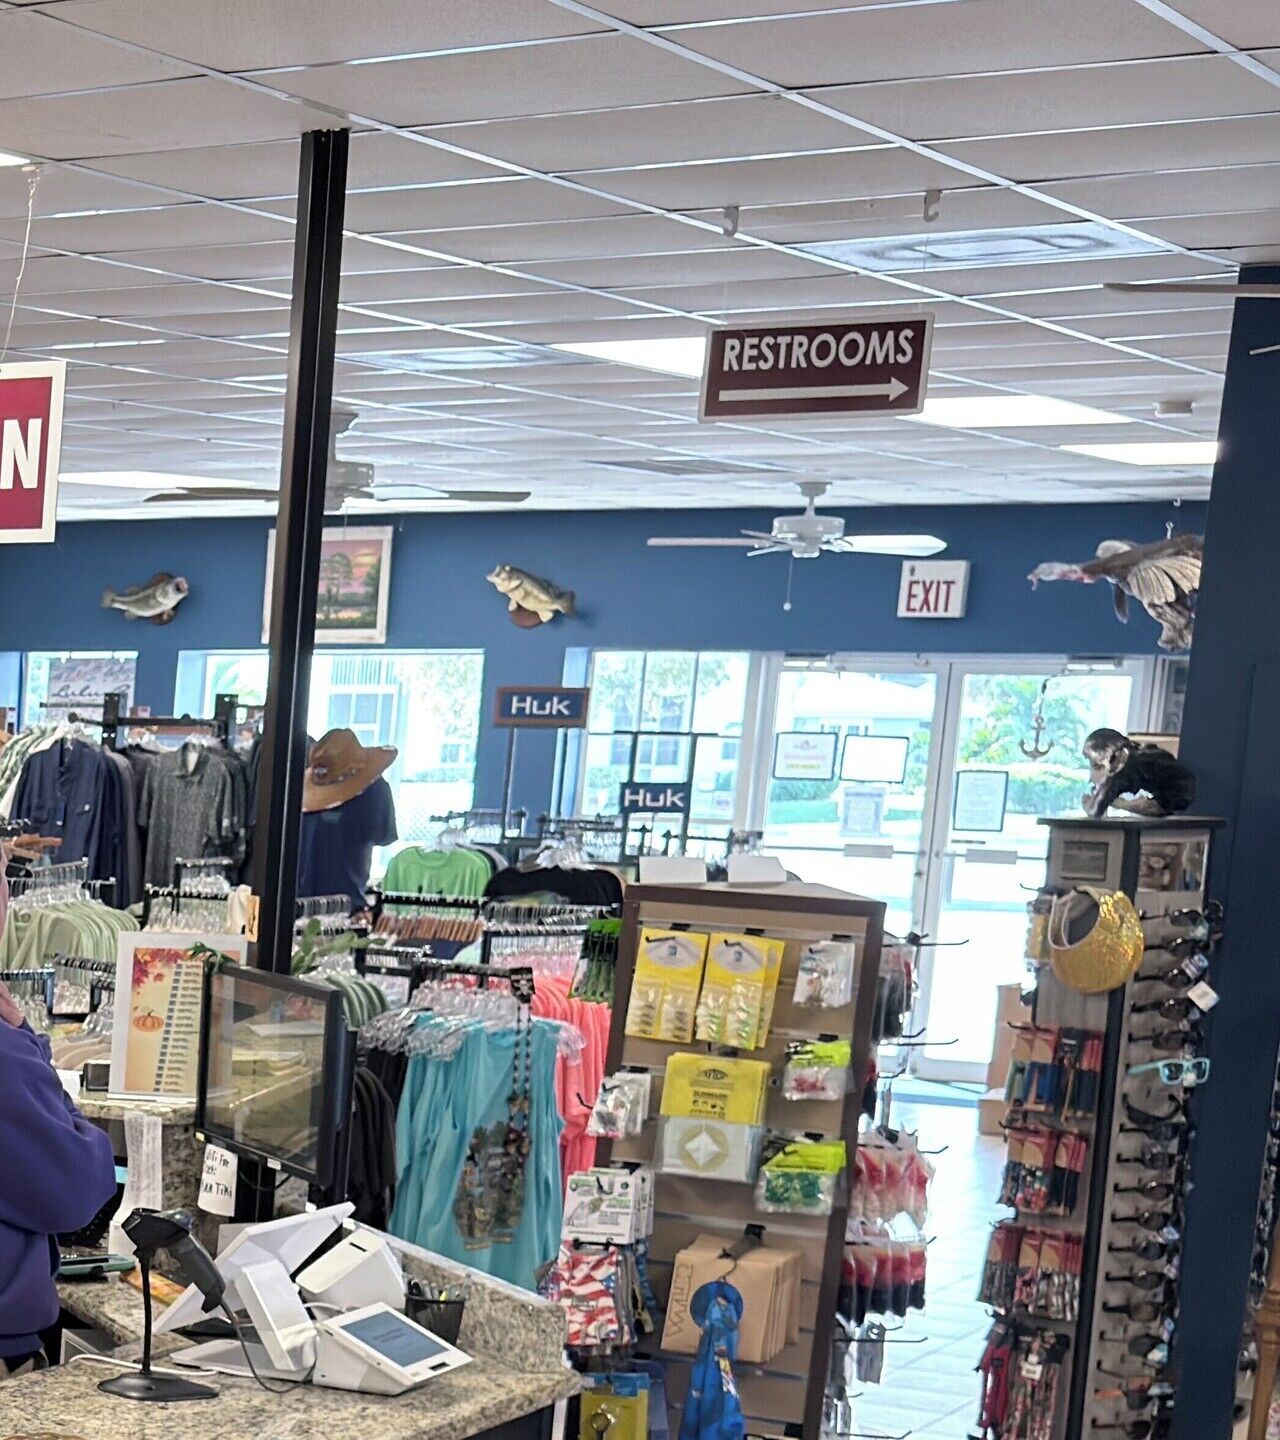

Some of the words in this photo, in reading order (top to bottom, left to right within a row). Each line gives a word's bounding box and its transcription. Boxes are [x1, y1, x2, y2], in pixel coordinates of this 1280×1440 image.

[722, 329, 914, 372] RESTROOMS
[905, 578, 955, 614] EXIT
[510, 694, 571, 718] Huk
[624, 786, 685, 811] Huk
